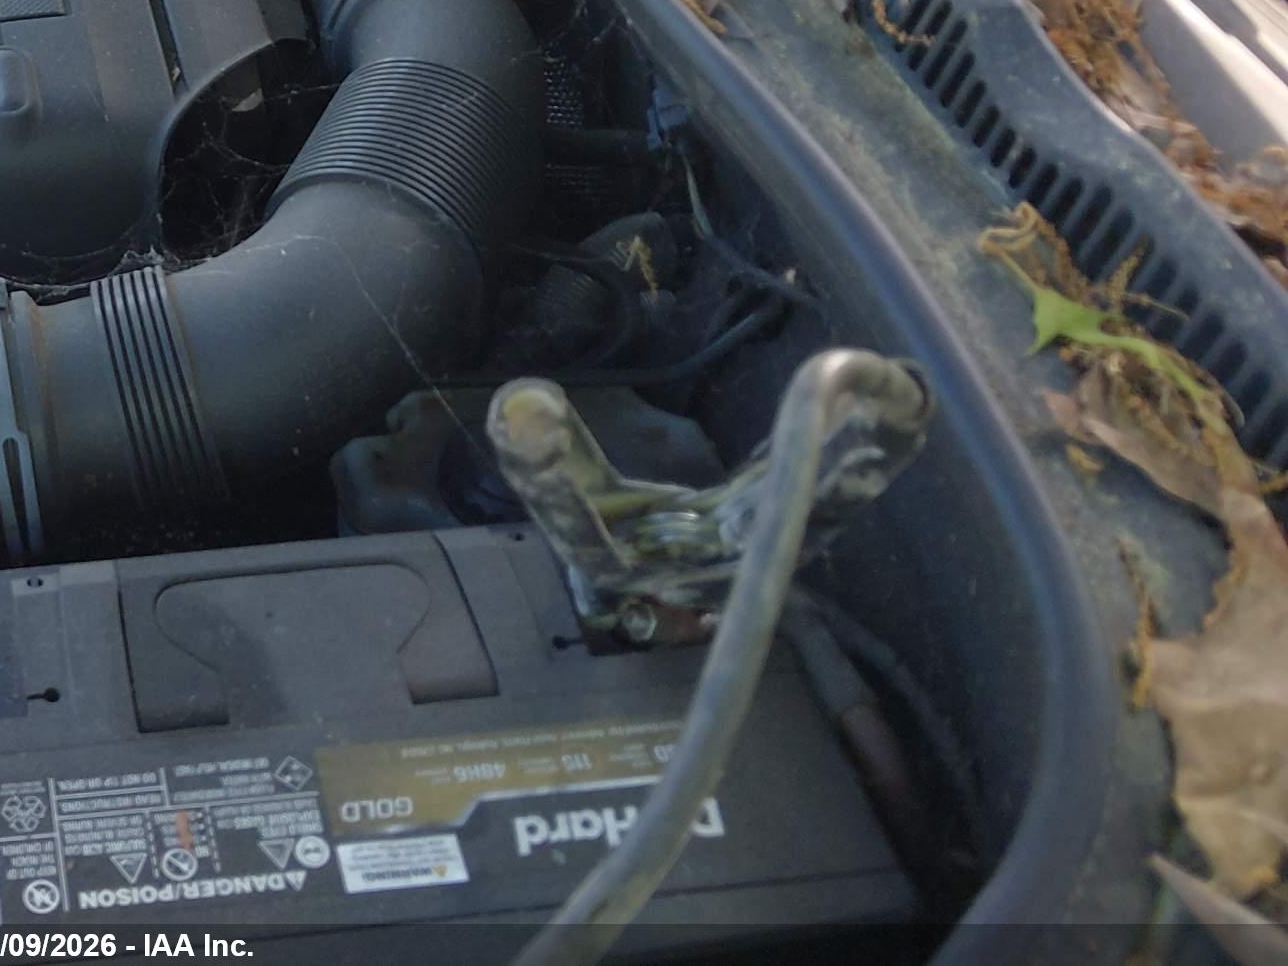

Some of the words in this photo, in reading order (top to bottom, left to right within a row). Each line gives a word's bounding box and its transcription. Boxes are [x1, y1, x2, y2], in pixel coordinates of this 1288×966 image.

[340, 796, 413, 823] GOLD
[512, 796, 725, 857] DHard
[78, 872, 286, 910] DANGER/POISON
